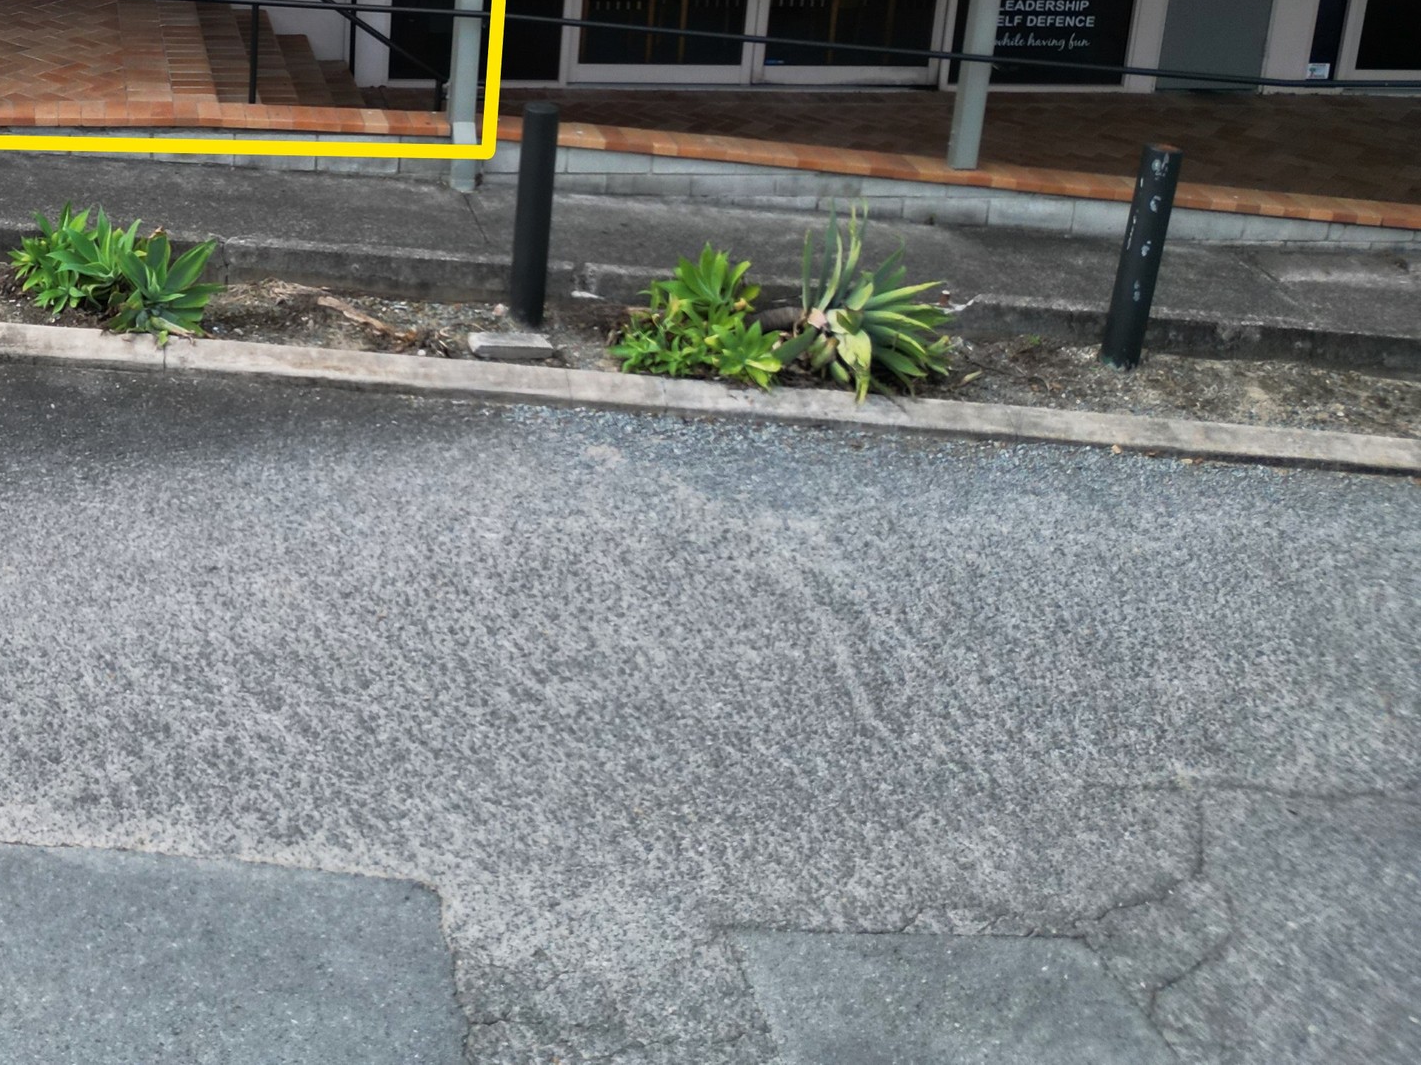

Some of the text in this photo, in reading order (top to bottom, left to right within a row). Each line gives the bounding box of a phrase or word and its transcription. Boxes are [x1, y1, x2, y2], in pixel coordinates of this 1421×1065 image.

[996, 15, 1095, 28] ELF DEFENCE
[1027, 32, 1065, 51] having
[1068, 32, 1091, 50] fun
